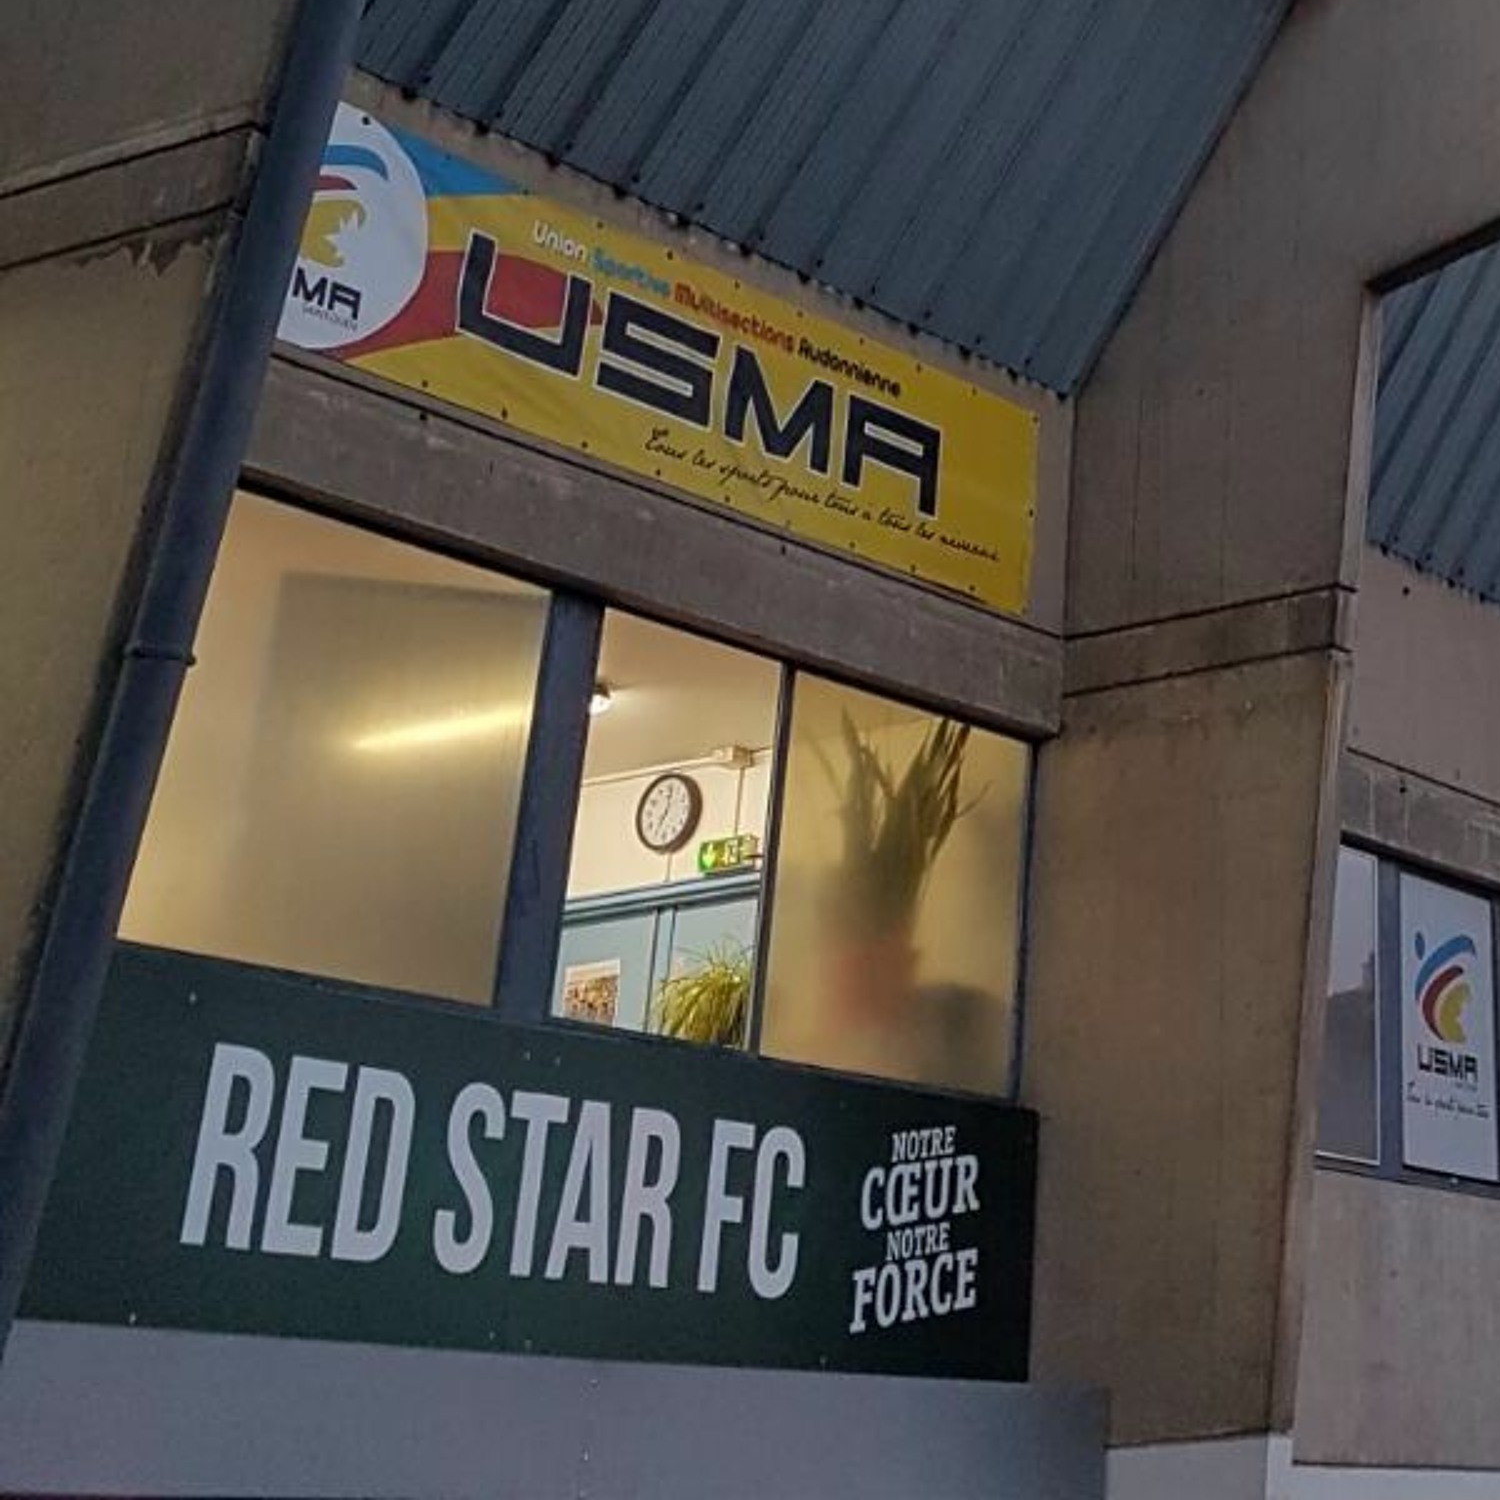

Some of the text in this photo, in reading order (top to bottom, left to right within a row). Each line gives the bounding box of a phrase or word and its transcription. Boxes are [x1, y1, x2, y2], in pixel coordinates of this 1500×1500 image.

[292, 266, 361, 320] MA
[534, 219, 587, 263] Union
[674, 281, 795, 354] Multisections
[798, 337, 901, 398] Audonnienne
[456, 228, 943, 519] USMA
[1417, 1043, 1479, 1083] USMA
[180, 1042, 806, 1301] RED STAR FC
[891, 1125, 957, 1163] NOTRE
[860, 1154, 981, 1231] CŒUR
[885, 1222, 951, 1262] NOTRE
[849, 1248, 978, 1334] FORCE
